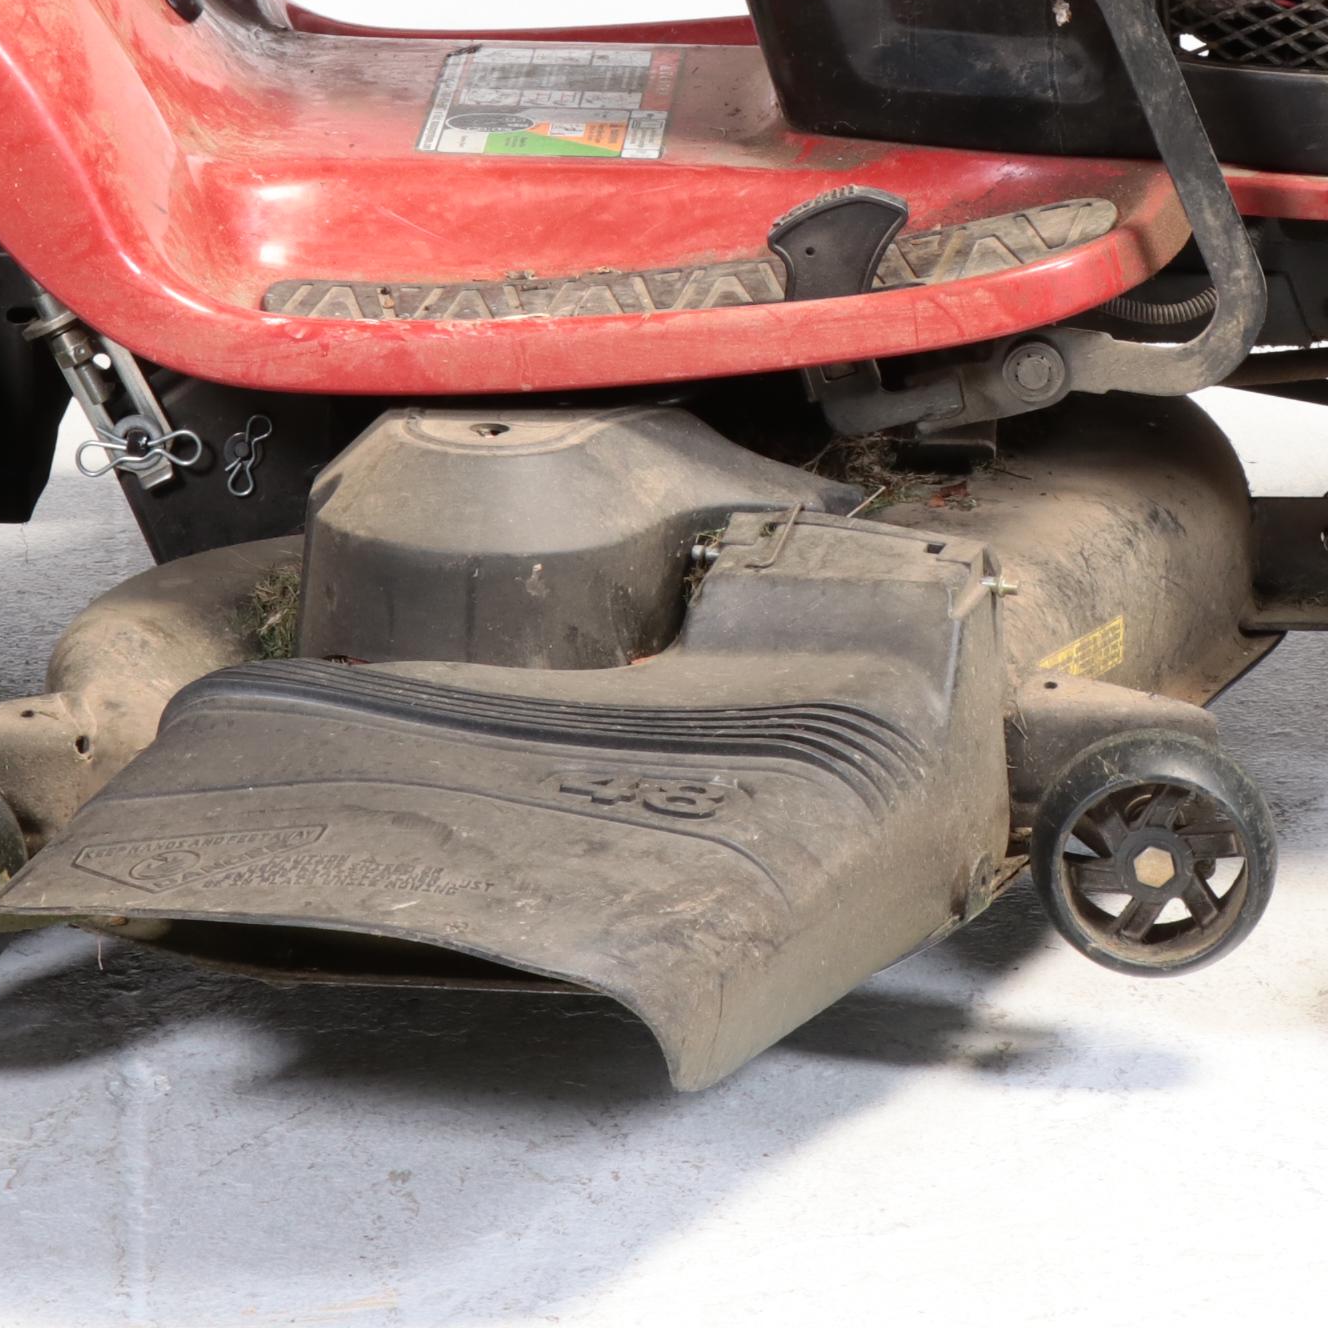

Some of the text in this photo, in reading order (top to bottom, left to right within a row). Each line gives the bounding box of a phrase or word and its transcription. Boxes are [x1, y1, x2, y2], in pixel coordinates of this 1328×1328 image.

[558, 775, 726, 820] 48
[83, 829, 314, 860] KEEP HANDS AND FEET AWAY
